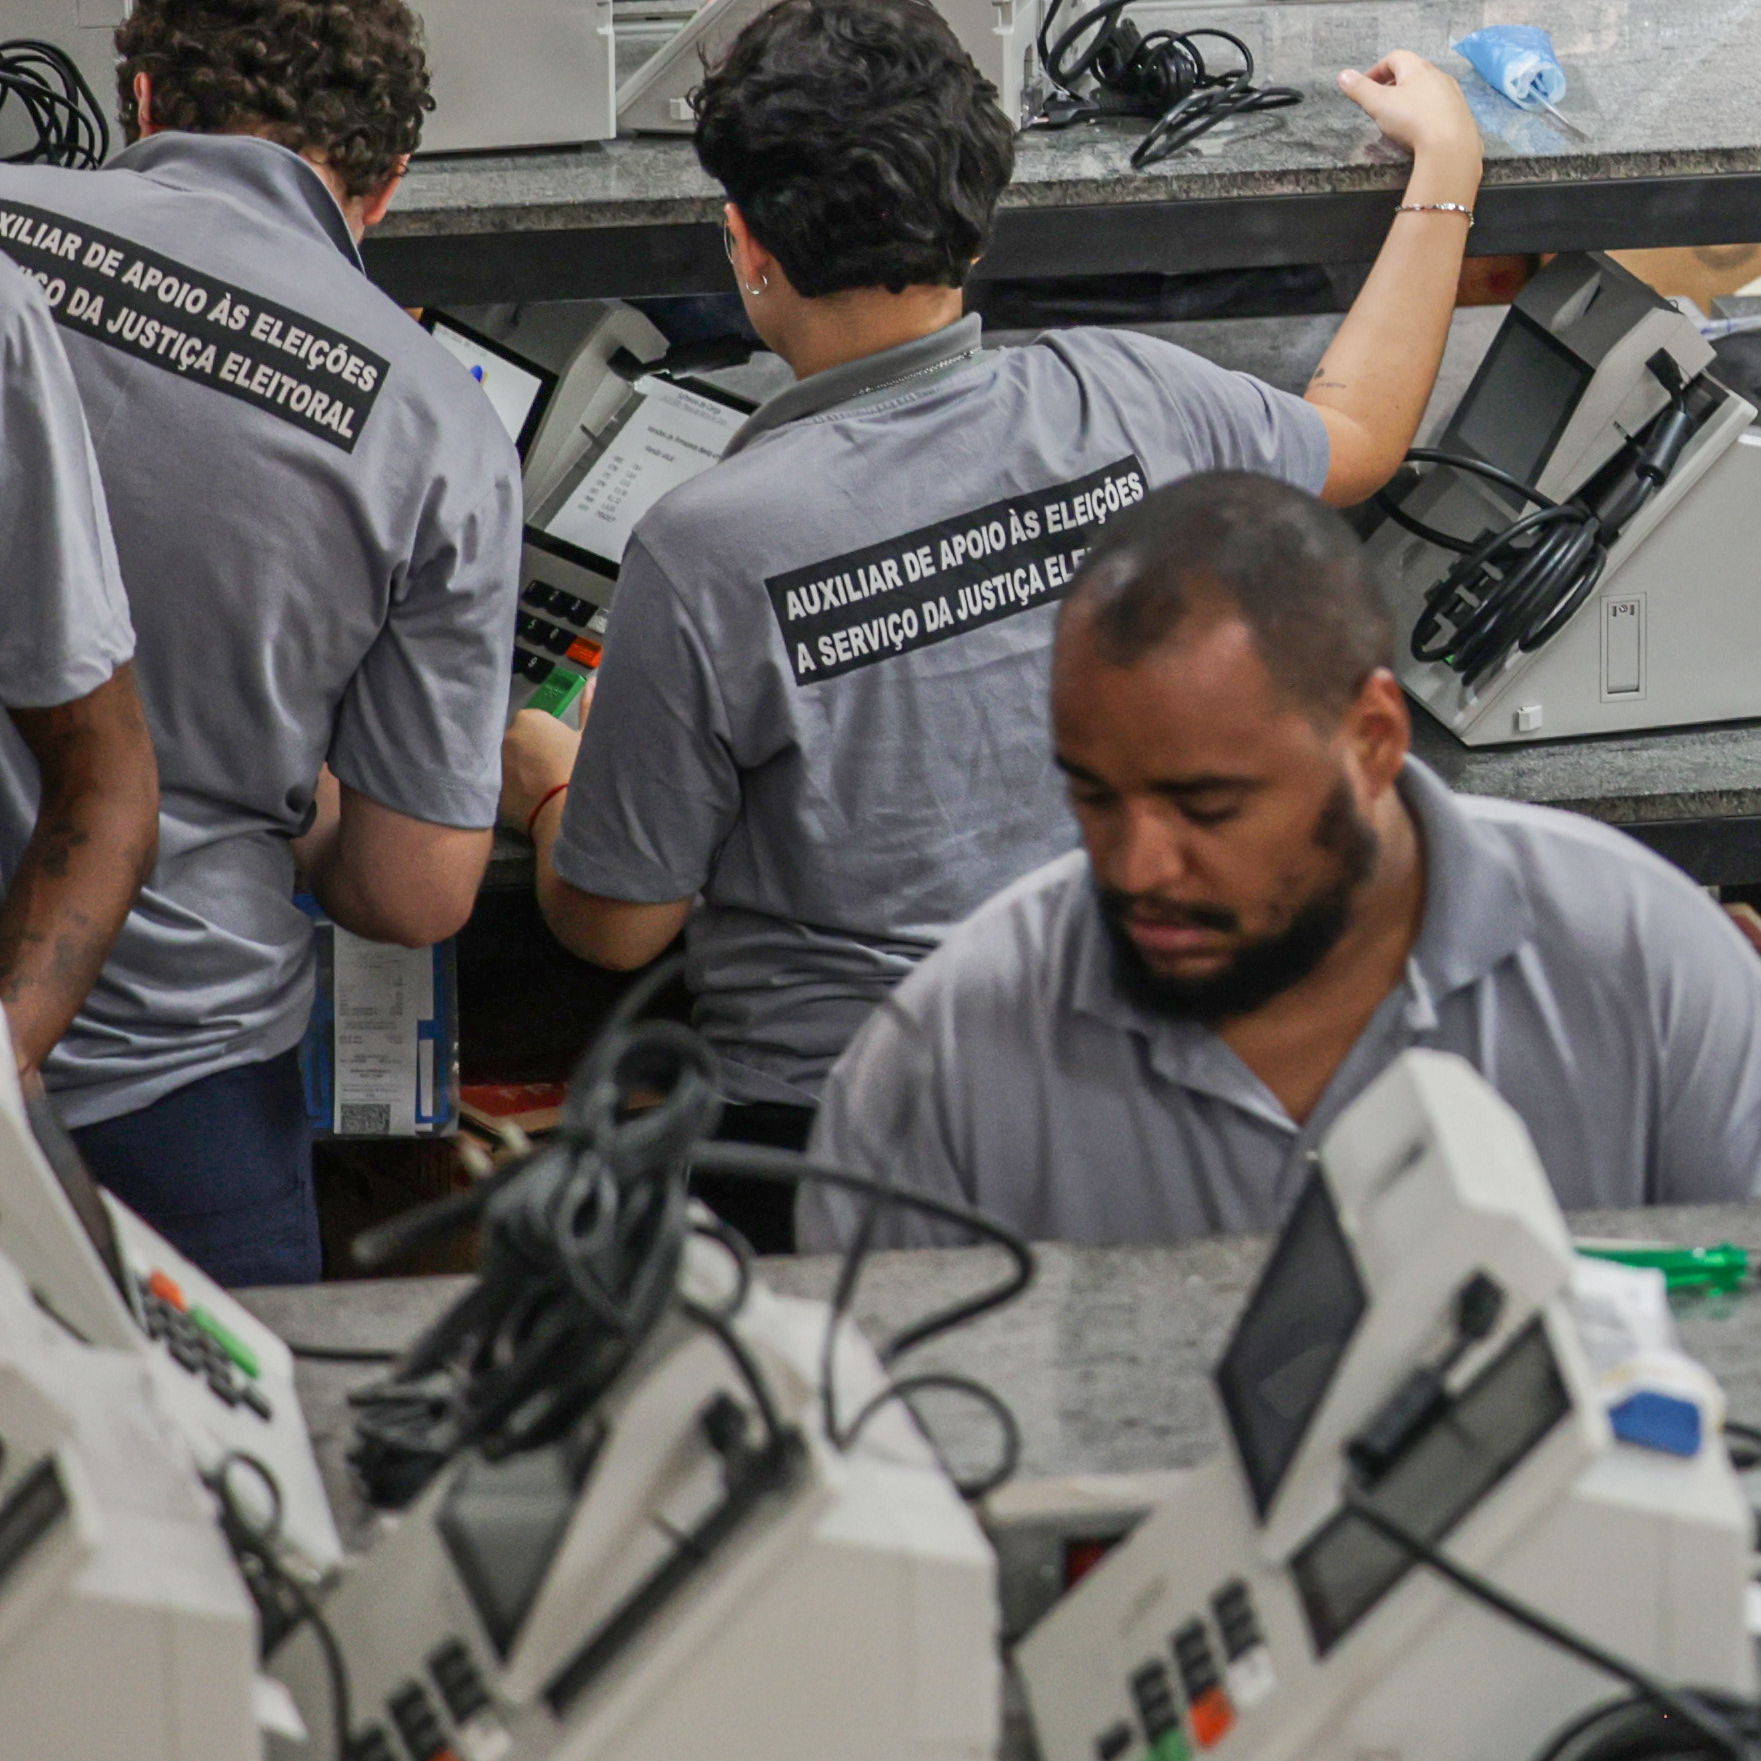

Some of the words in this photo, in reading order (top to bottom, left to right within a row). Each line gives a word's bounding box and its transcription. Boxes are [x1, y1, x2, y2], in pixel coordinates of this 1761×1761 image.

[66, 285, 103, 326] DA
[106, 306, 218, 374] JUSTIÇA
[219, 351, 354, 438] ELEITORAL
[83, 241, 124, 278] DE
[121, 261, 207, 314] APOIO
[207, 292, 250, 330] ÀS
[250, 312, 378, 392] ELEIÇÕES
[786, 558, 903, 621] AUXILIAR
[902, 546, 936, 583] DE
[940, 521, 1006, 571] APOIO
[1009, 509, 1041, 545] ÀS
[1045, 471, 1144, 534] ELEIÇÕES
[796, 642, 817, 674] A
[818, 607, 919, 666] SERVIÇO
[922, 596, 955, 633] DA
[956, 564, 1045, 621] JUSTIÇA
